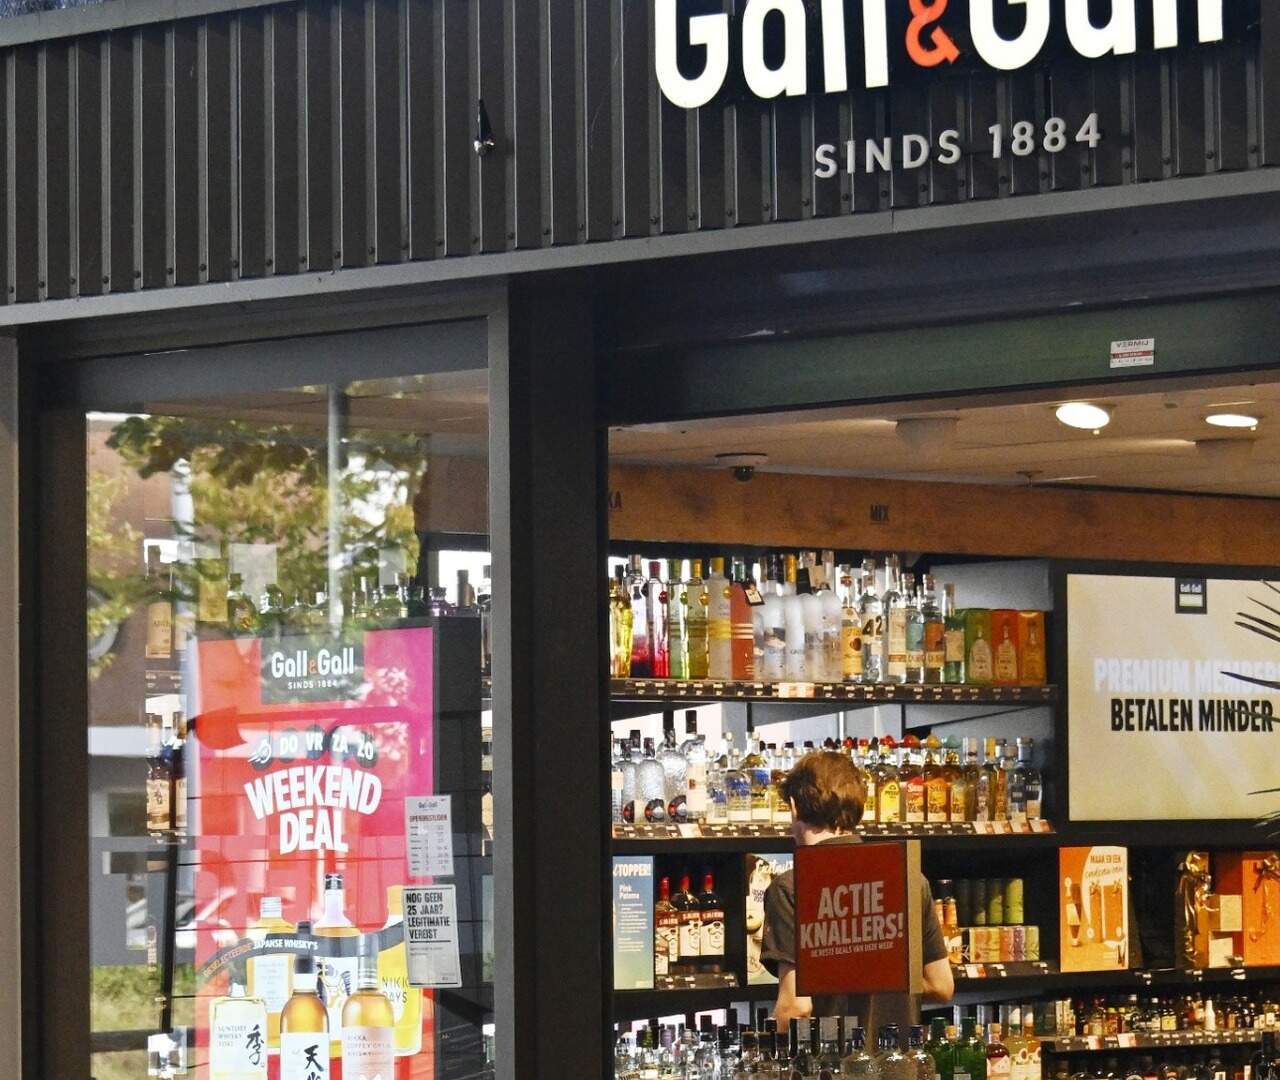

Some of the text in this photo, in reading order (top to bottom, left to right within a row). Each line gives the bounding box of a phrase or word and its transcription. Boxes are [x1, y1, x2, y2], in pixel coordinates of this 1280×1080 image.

[815, 113, 1102, 178] SINDS 1884
[1093, 657, 1190, 693] PREMIUM
[1111, 698, 1274, 732] BETALEN MINDER
[244, 765, 382, 820] WEEKEND
[279, 808, 349, 855] DEAL
[406, 892, 443, 903] NOG GEEN
[407, 905, 418, 915] 25
[817, 880, 884, 919] ACTIE
[407, 916, 450, 927] LEGITIMATIE
[409, 929, 438, 939] VEREIST
[800, 913, 904, 949] KNALLERS!
